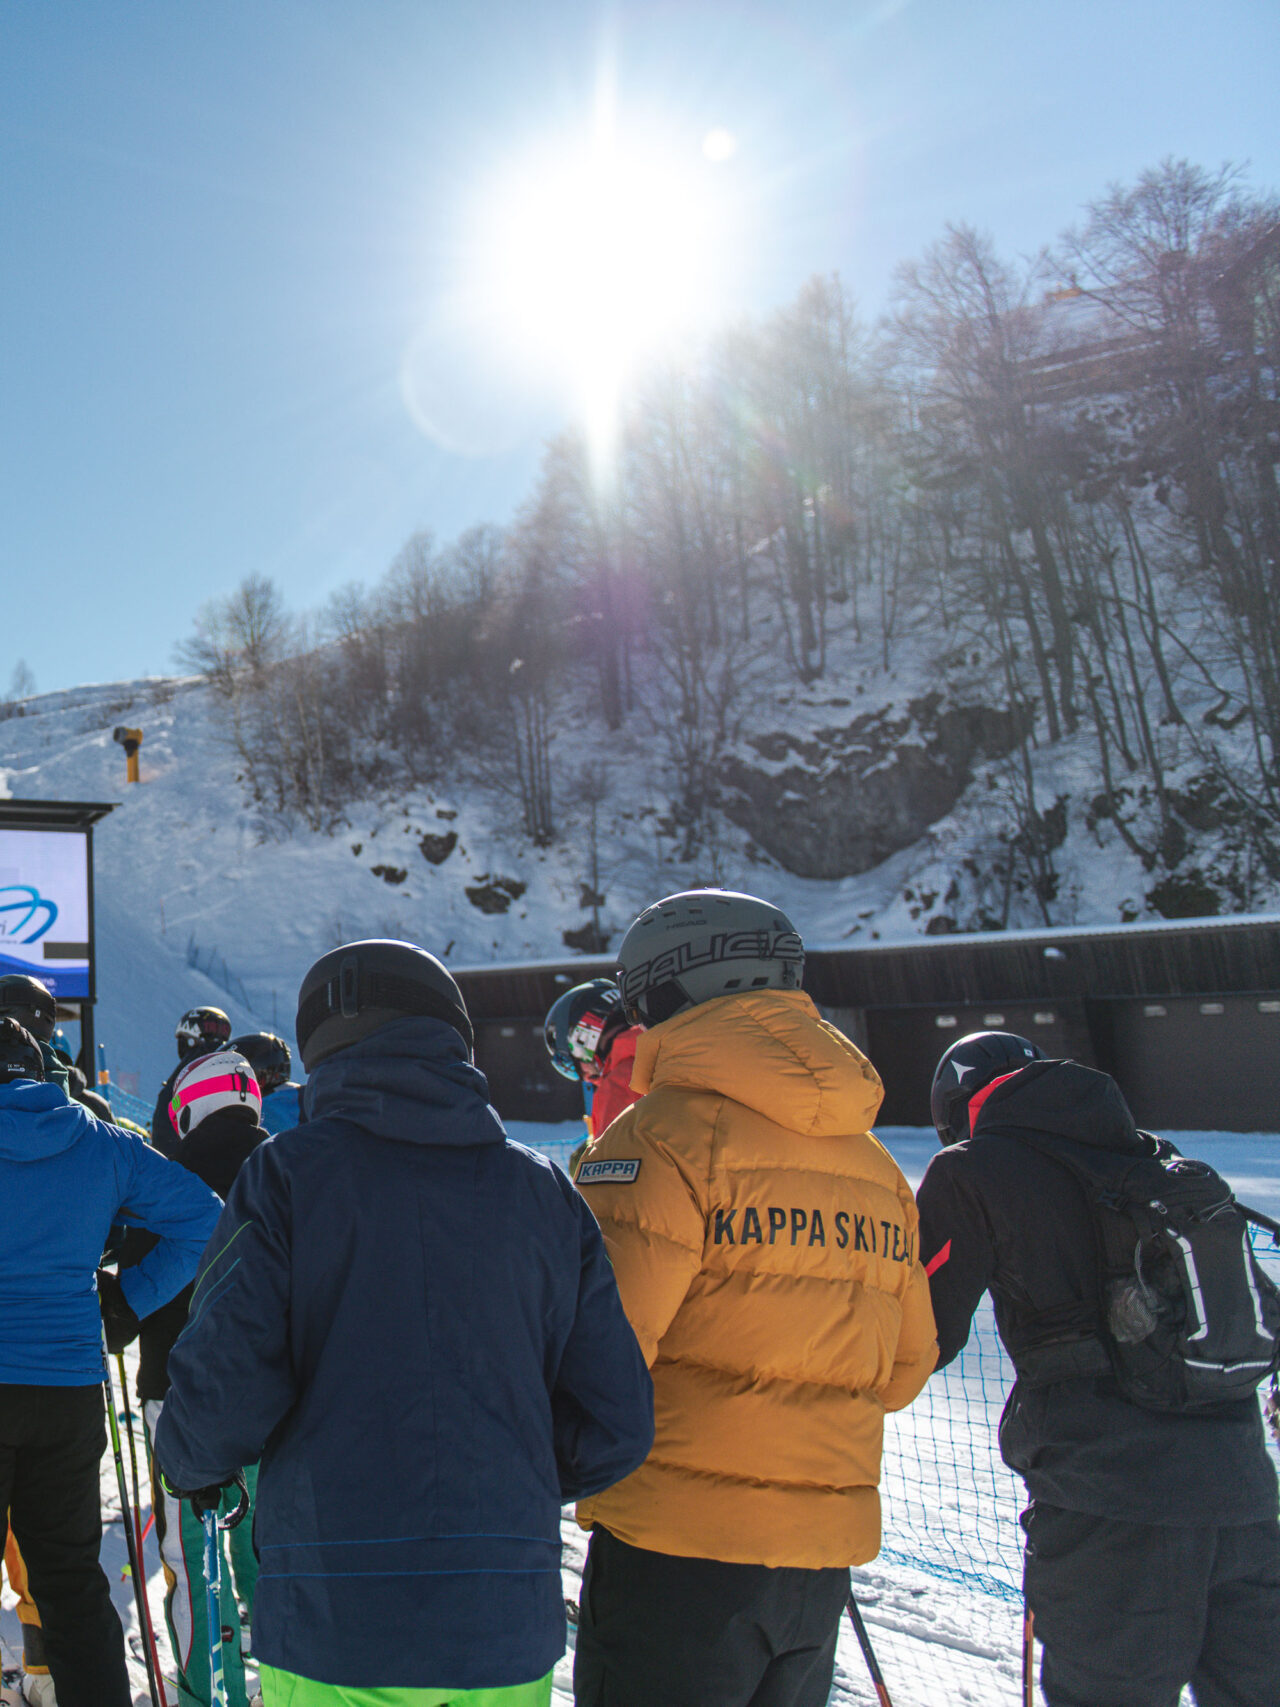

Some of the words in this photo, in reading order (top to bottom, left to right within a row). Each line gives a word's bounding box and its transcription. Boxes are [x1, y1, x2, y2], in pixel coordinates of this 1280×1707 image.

[582, 1162, 636, 1177] KAPPA
[714, 1207, 826, 1247] KAPPA
[835, 1211, 877, 1254] SKI
